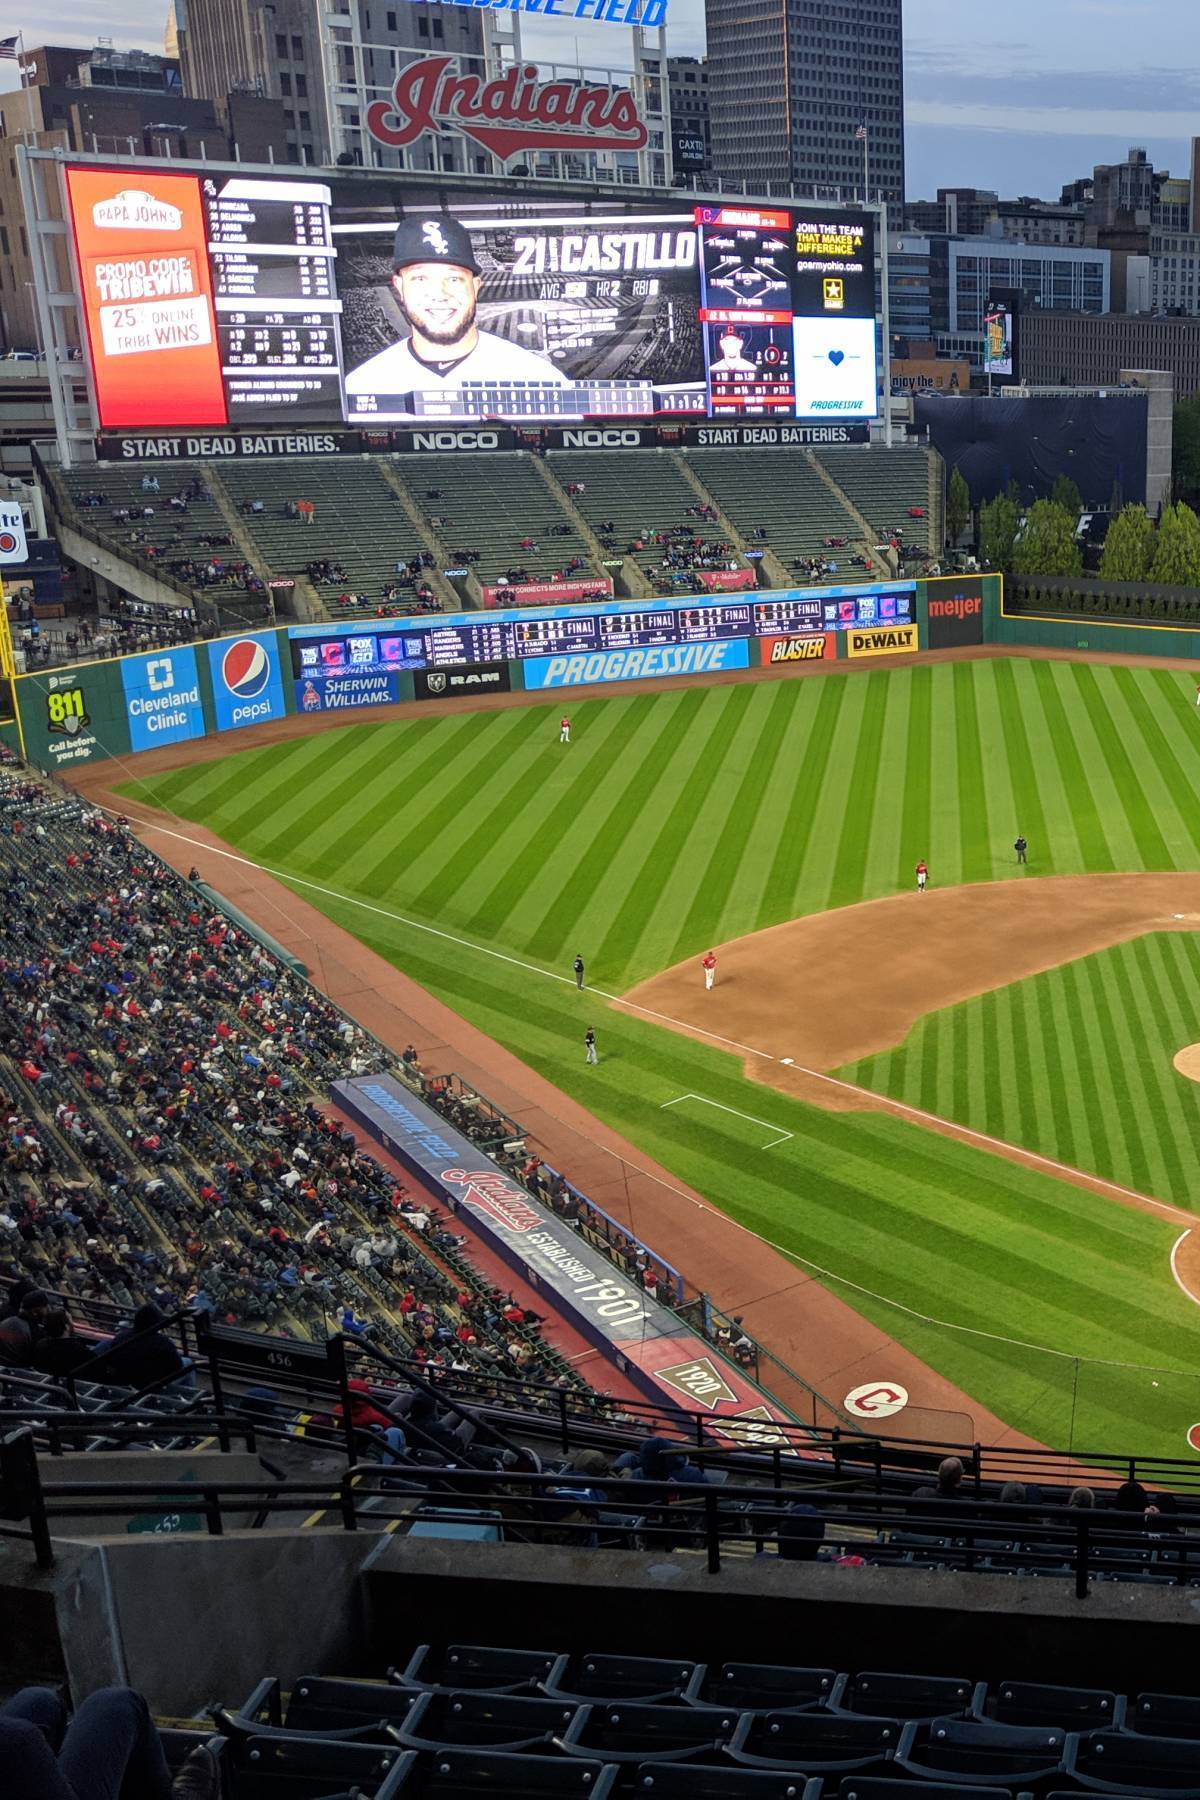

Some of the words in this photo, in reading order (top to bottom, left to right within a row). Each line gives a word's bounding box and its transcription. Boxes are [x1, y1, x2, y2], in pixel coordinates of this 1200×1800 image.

[574, 0, 666, 26] FIELD
[367, 56, 648, 161] Indians
[98, 205, 131, 220] PAPA
[797, 223, 817, 233] JOIN
[820, 224, 837, 234] THE
[839, 225, 863, 236] TEAM
[797, 233, 820, 242] THAT
[821, 235, 853, 245] MAKES
[855, 237, 861, 245] A
[512, 237, 545, 274] 21
[560, 231, 697, 271] CASTILLO
[797, 243, 855, 255] DIFFERENCE.
[95, 262, 147, 279] PROMO
[797, 260, 862, 272] goarmyohio.com
[96, 269, 193, 301] TRIBEWIN
[540, 283, 560, 299] AVG
[596, 281, 610, 296] HR
[610, 280, 620, 296] 2
[633, 279, 648, 296] RBI
[155, 323, 200, 345] WINS
[892, 376, 915, 389] njoy
[917, 376, 933, 387] the
[810, 400, 864, 409] PROGRESSIVE
[414, 432, 498, 450] NOCO
[563, 429, 640, 447] NOCO
[699, 429, 739, 444] START
[743, 428, 777, 443] DEAD
[781, 426, 851, 442] BATTERIES.
[122, 438, 183, 458] START
[187, 438, 237, 456] DEAD
[241, 434, 341, 453] BATTERIES.
[516, 585, 548, 594] CONNECTS
[549, 583, 567, 591] MORE
[591, 581, 607, 589] FANS
[798, 603, 819, 615] FINAL
[859, 598, 875, 607] FOX
[929, 595, 981, 618] meijer
[648, 615, 673, 627] FINAL
[724, 609, 747, 621] FINAL
[567, 621, 592, 635] FINAL
[350, 638, 372, 649] FOX
[771, 638, 825, 663] BLASTER
[352, 653, 373, 663] GO
[545, 643, 729, 685] PROGRESSIVE
[325, 676, 388, 693] SHERWIN
[450, 672, 500, 686] RAM
[49, 689, 84, 722] 811
[129, 687, 198, 716] Cleveland
[325, 690, 392, 708] WILLIAMS.
[147, 710, 187, 732] Clinic
[232, 701, 272, 723] pepsi
[49, 741, 66, 752] Call
[67, 736, 96, 748] before
[57, 751, 73, 764] you
[75, 747, 92, 757] dig.
[415, 1134, 460, 1158] FIELD
[441, 1168, 546, 1233] Indians
[526, 1231, 596, 1283] ESTABLISHED
[574, 1278, 652, 1327] 1901
[675, 1366, 722, 1395] 1920
[854, 1389, 901, 1411] C
